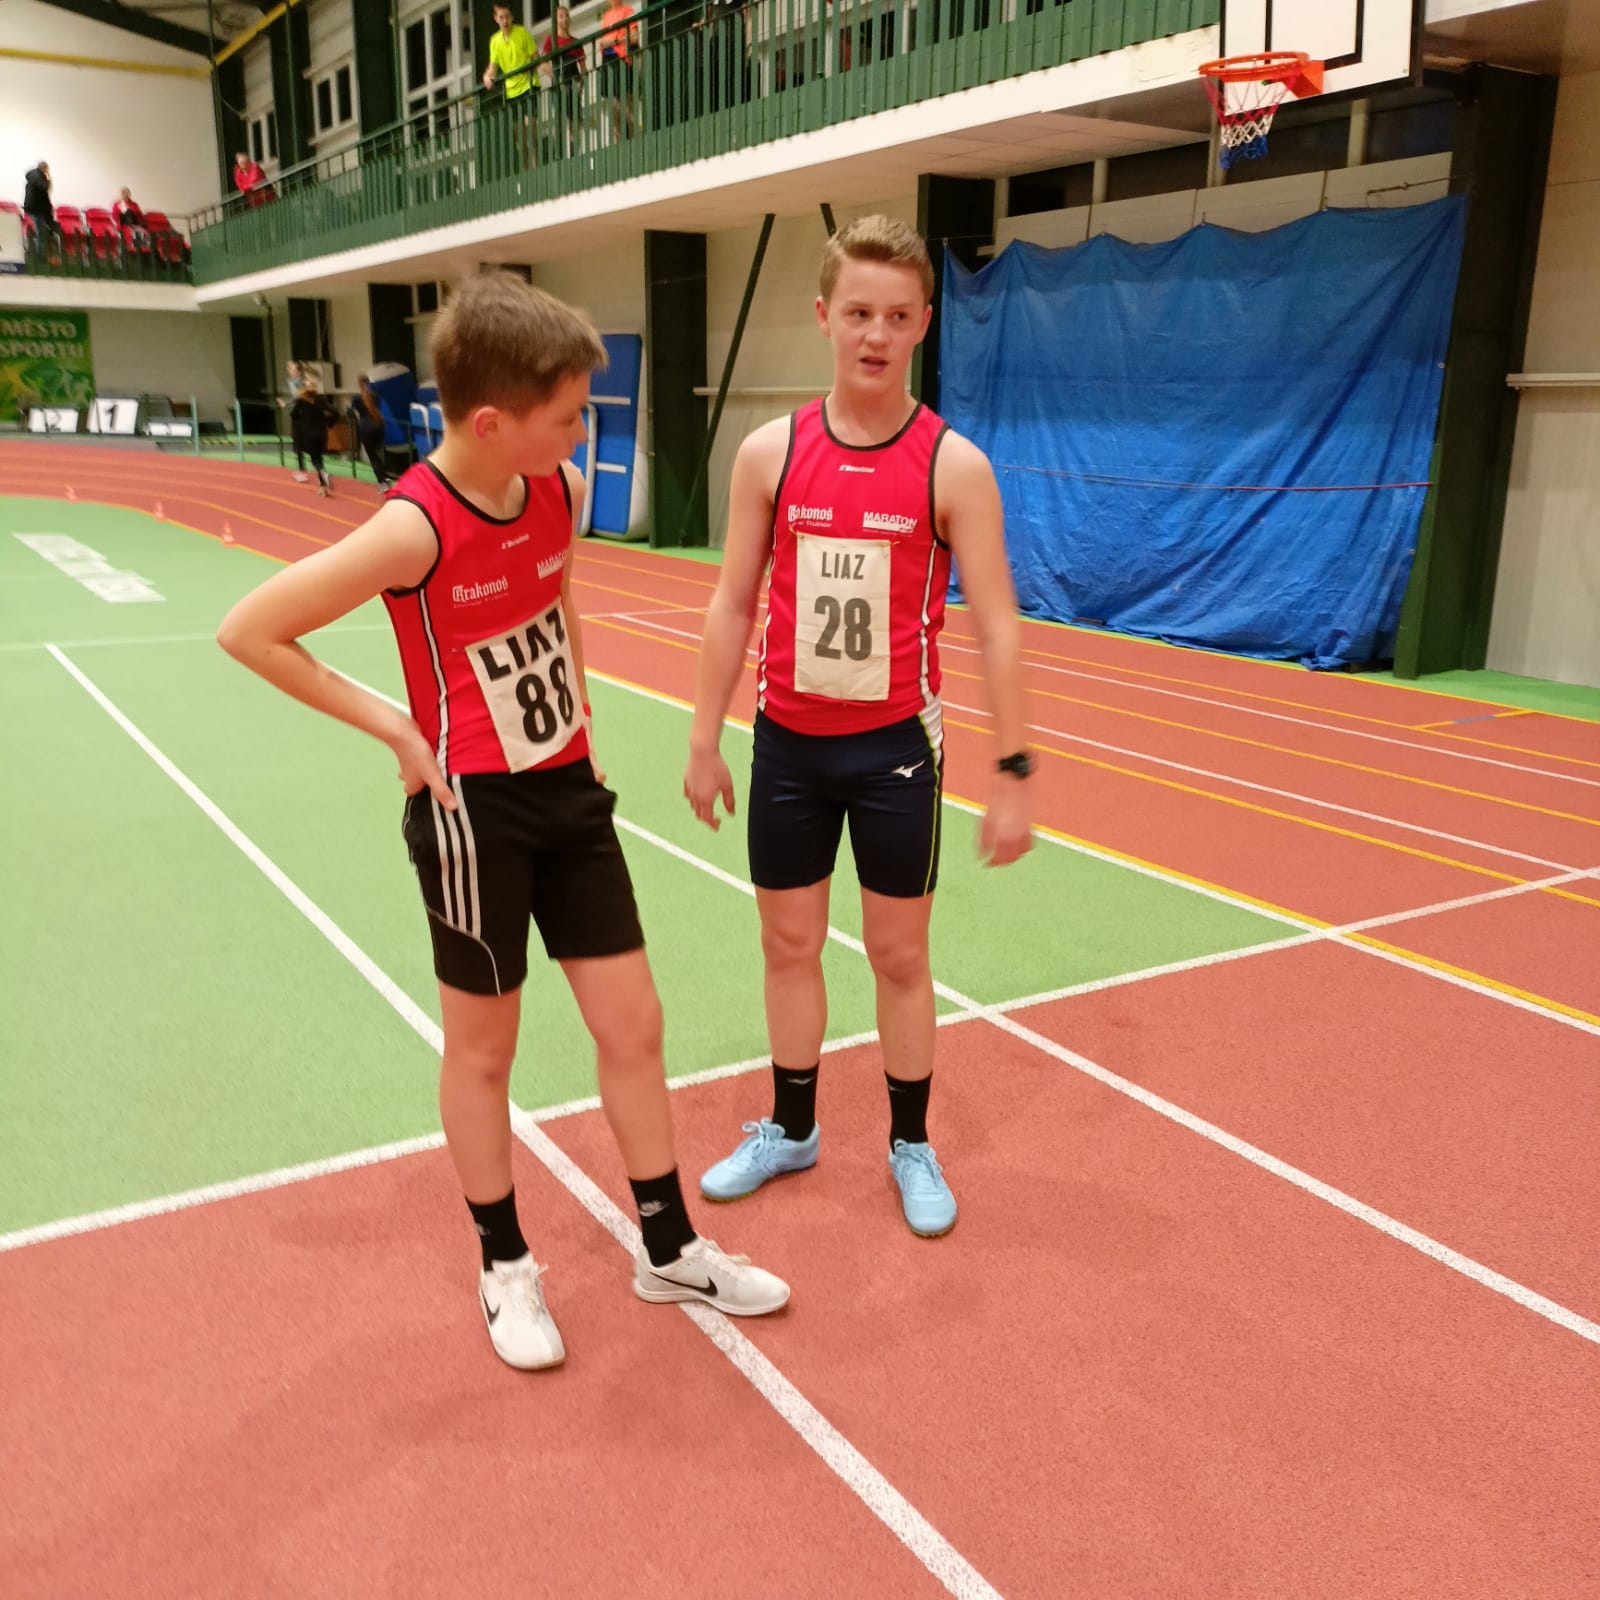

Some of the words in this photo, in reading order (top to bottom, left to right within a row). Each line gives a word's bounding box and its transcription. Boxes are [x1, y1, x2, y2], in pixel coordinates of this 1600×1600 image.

[104, 403, 118, 431] 1
[863, 511, 918, 528] MARATON
[821, 552, 866, 580] LIAZ
[477, 607, 566, 682] LIAZ
[813, 595, 873, 662] 28
[515, 656, 575, 744] 88
